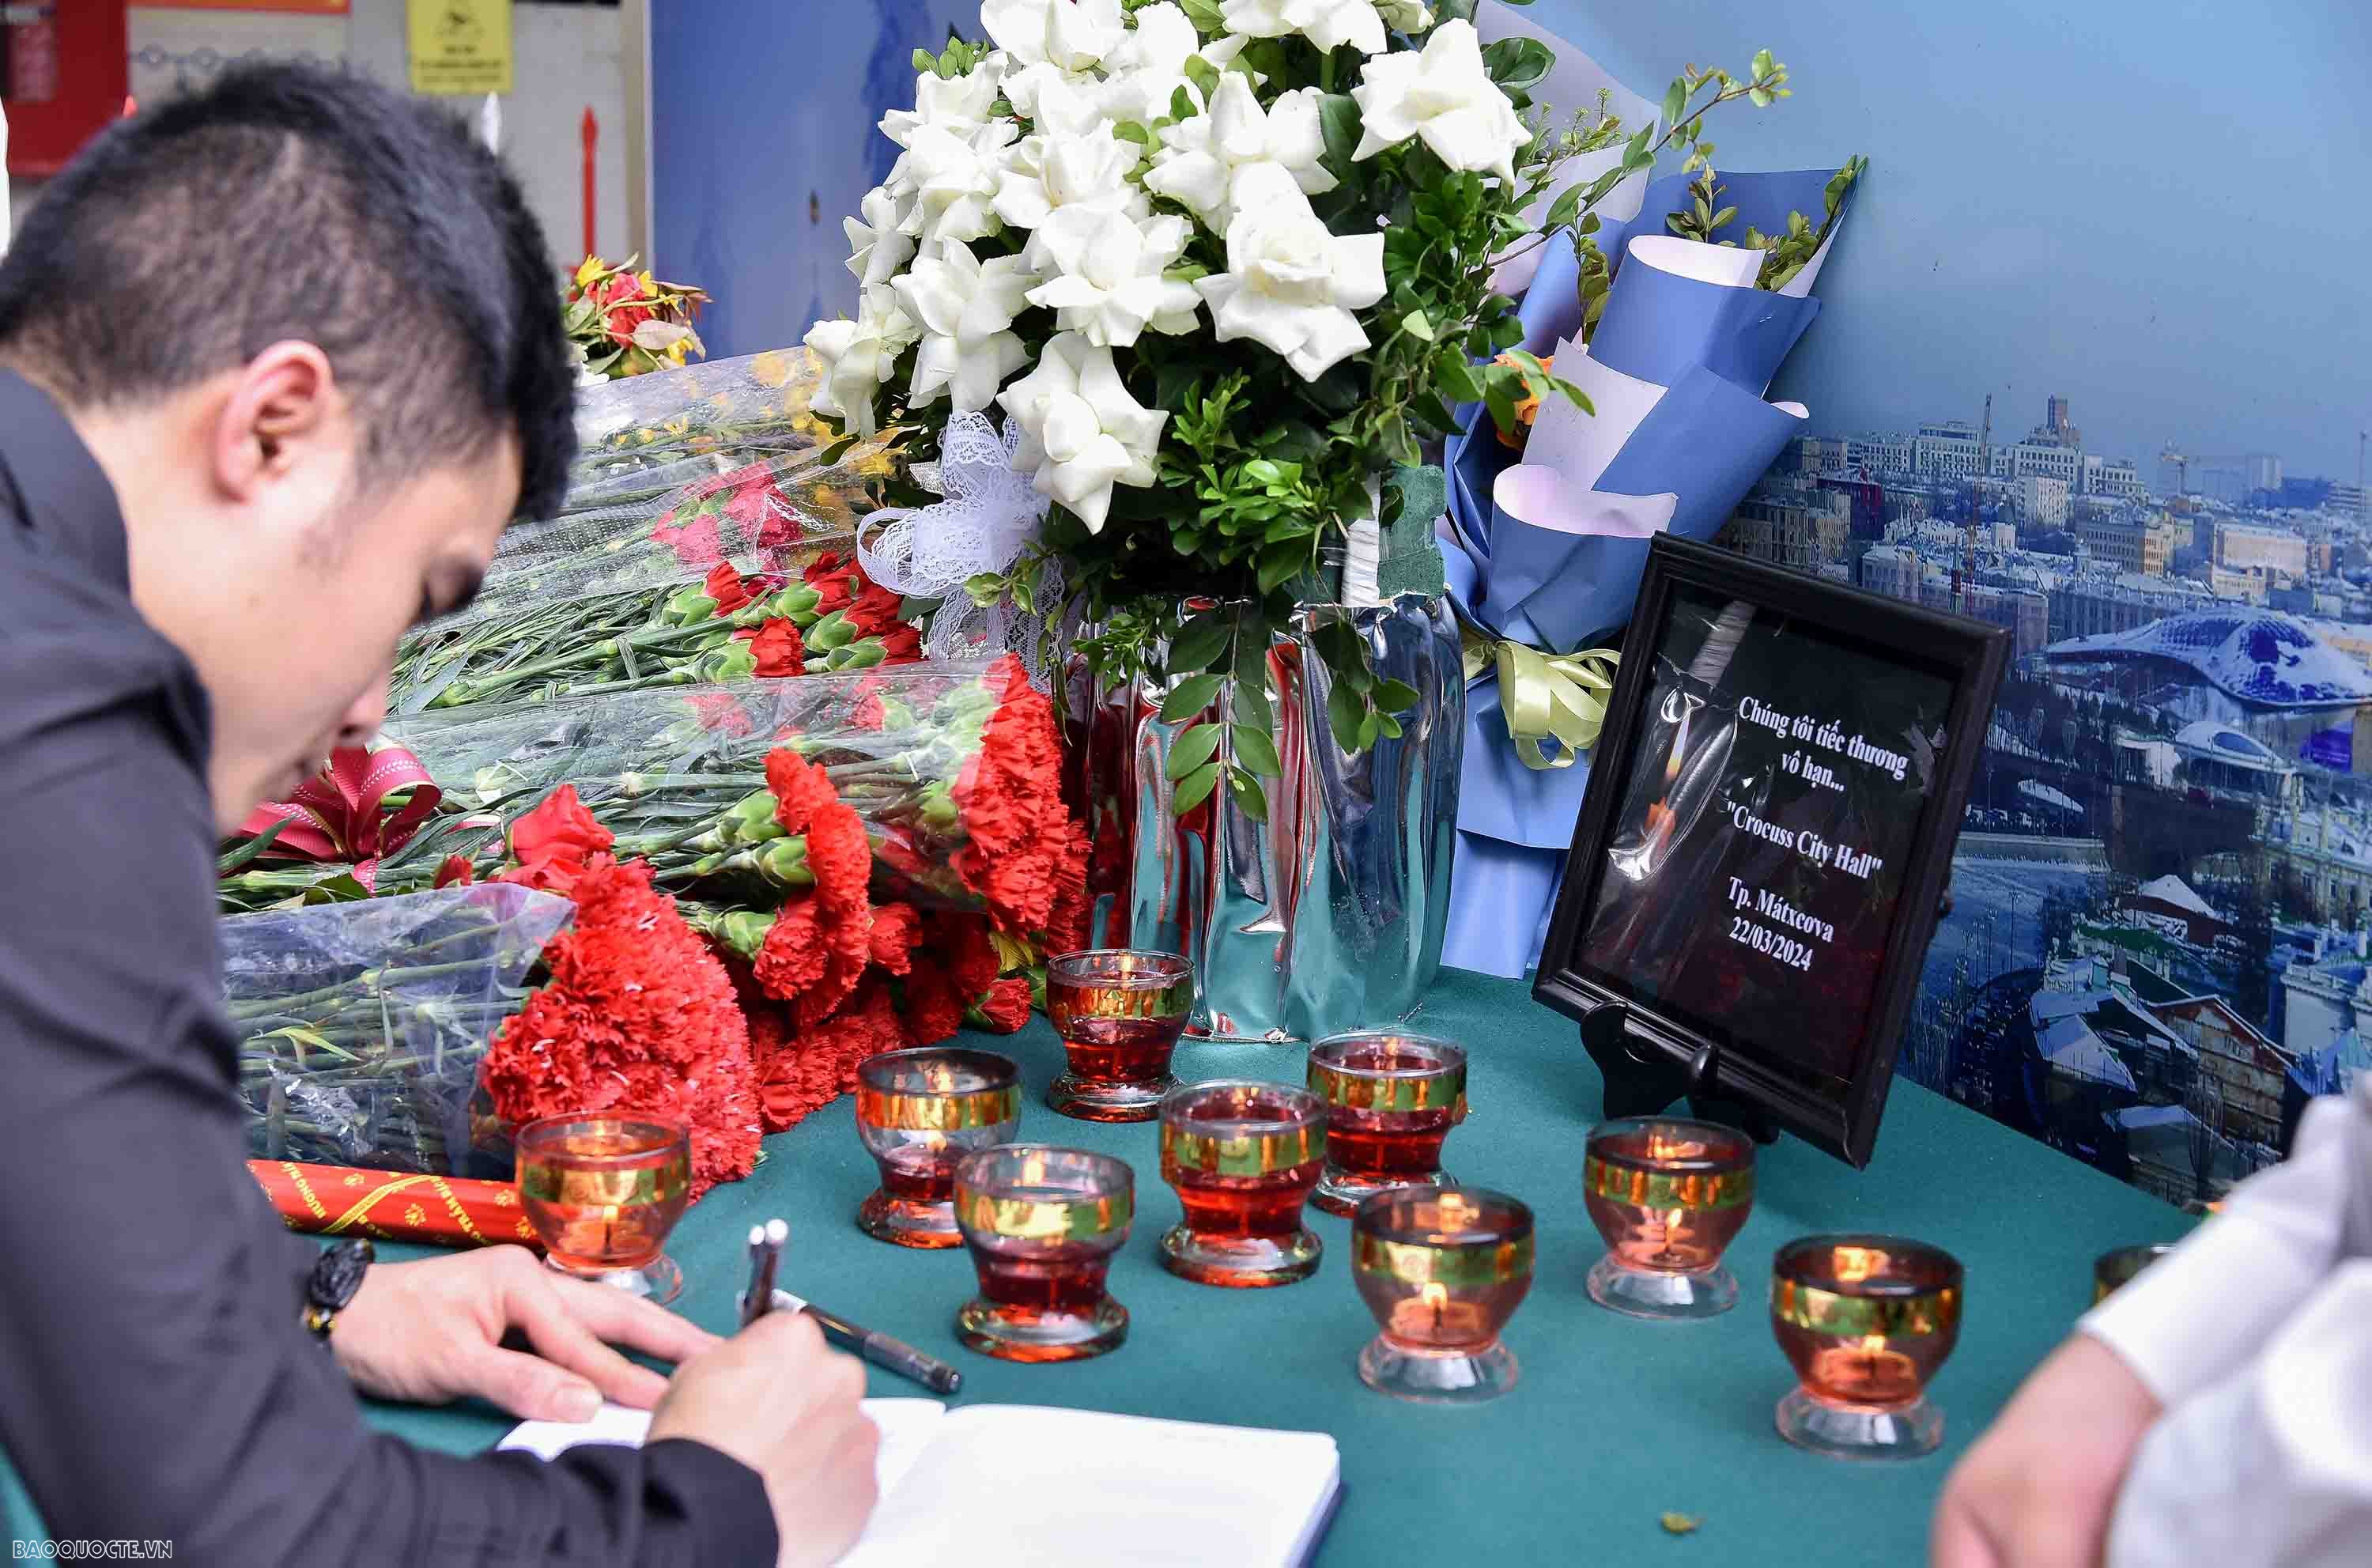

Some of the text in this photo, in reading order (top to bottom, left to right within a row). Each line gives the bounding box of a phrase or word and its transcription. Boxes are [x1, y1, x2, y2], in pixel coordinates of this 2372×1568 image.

[1739, 696, 1909, 780] Chúng tôi tiếc thương
[1781, 750, 1801, 774] vô
[1727, 800, 1883, 879] "Crocuss City Hall"
[1728, 875, 1752, 910] Tp.
[1728, 916, 1814, 972] 22/03/2024
